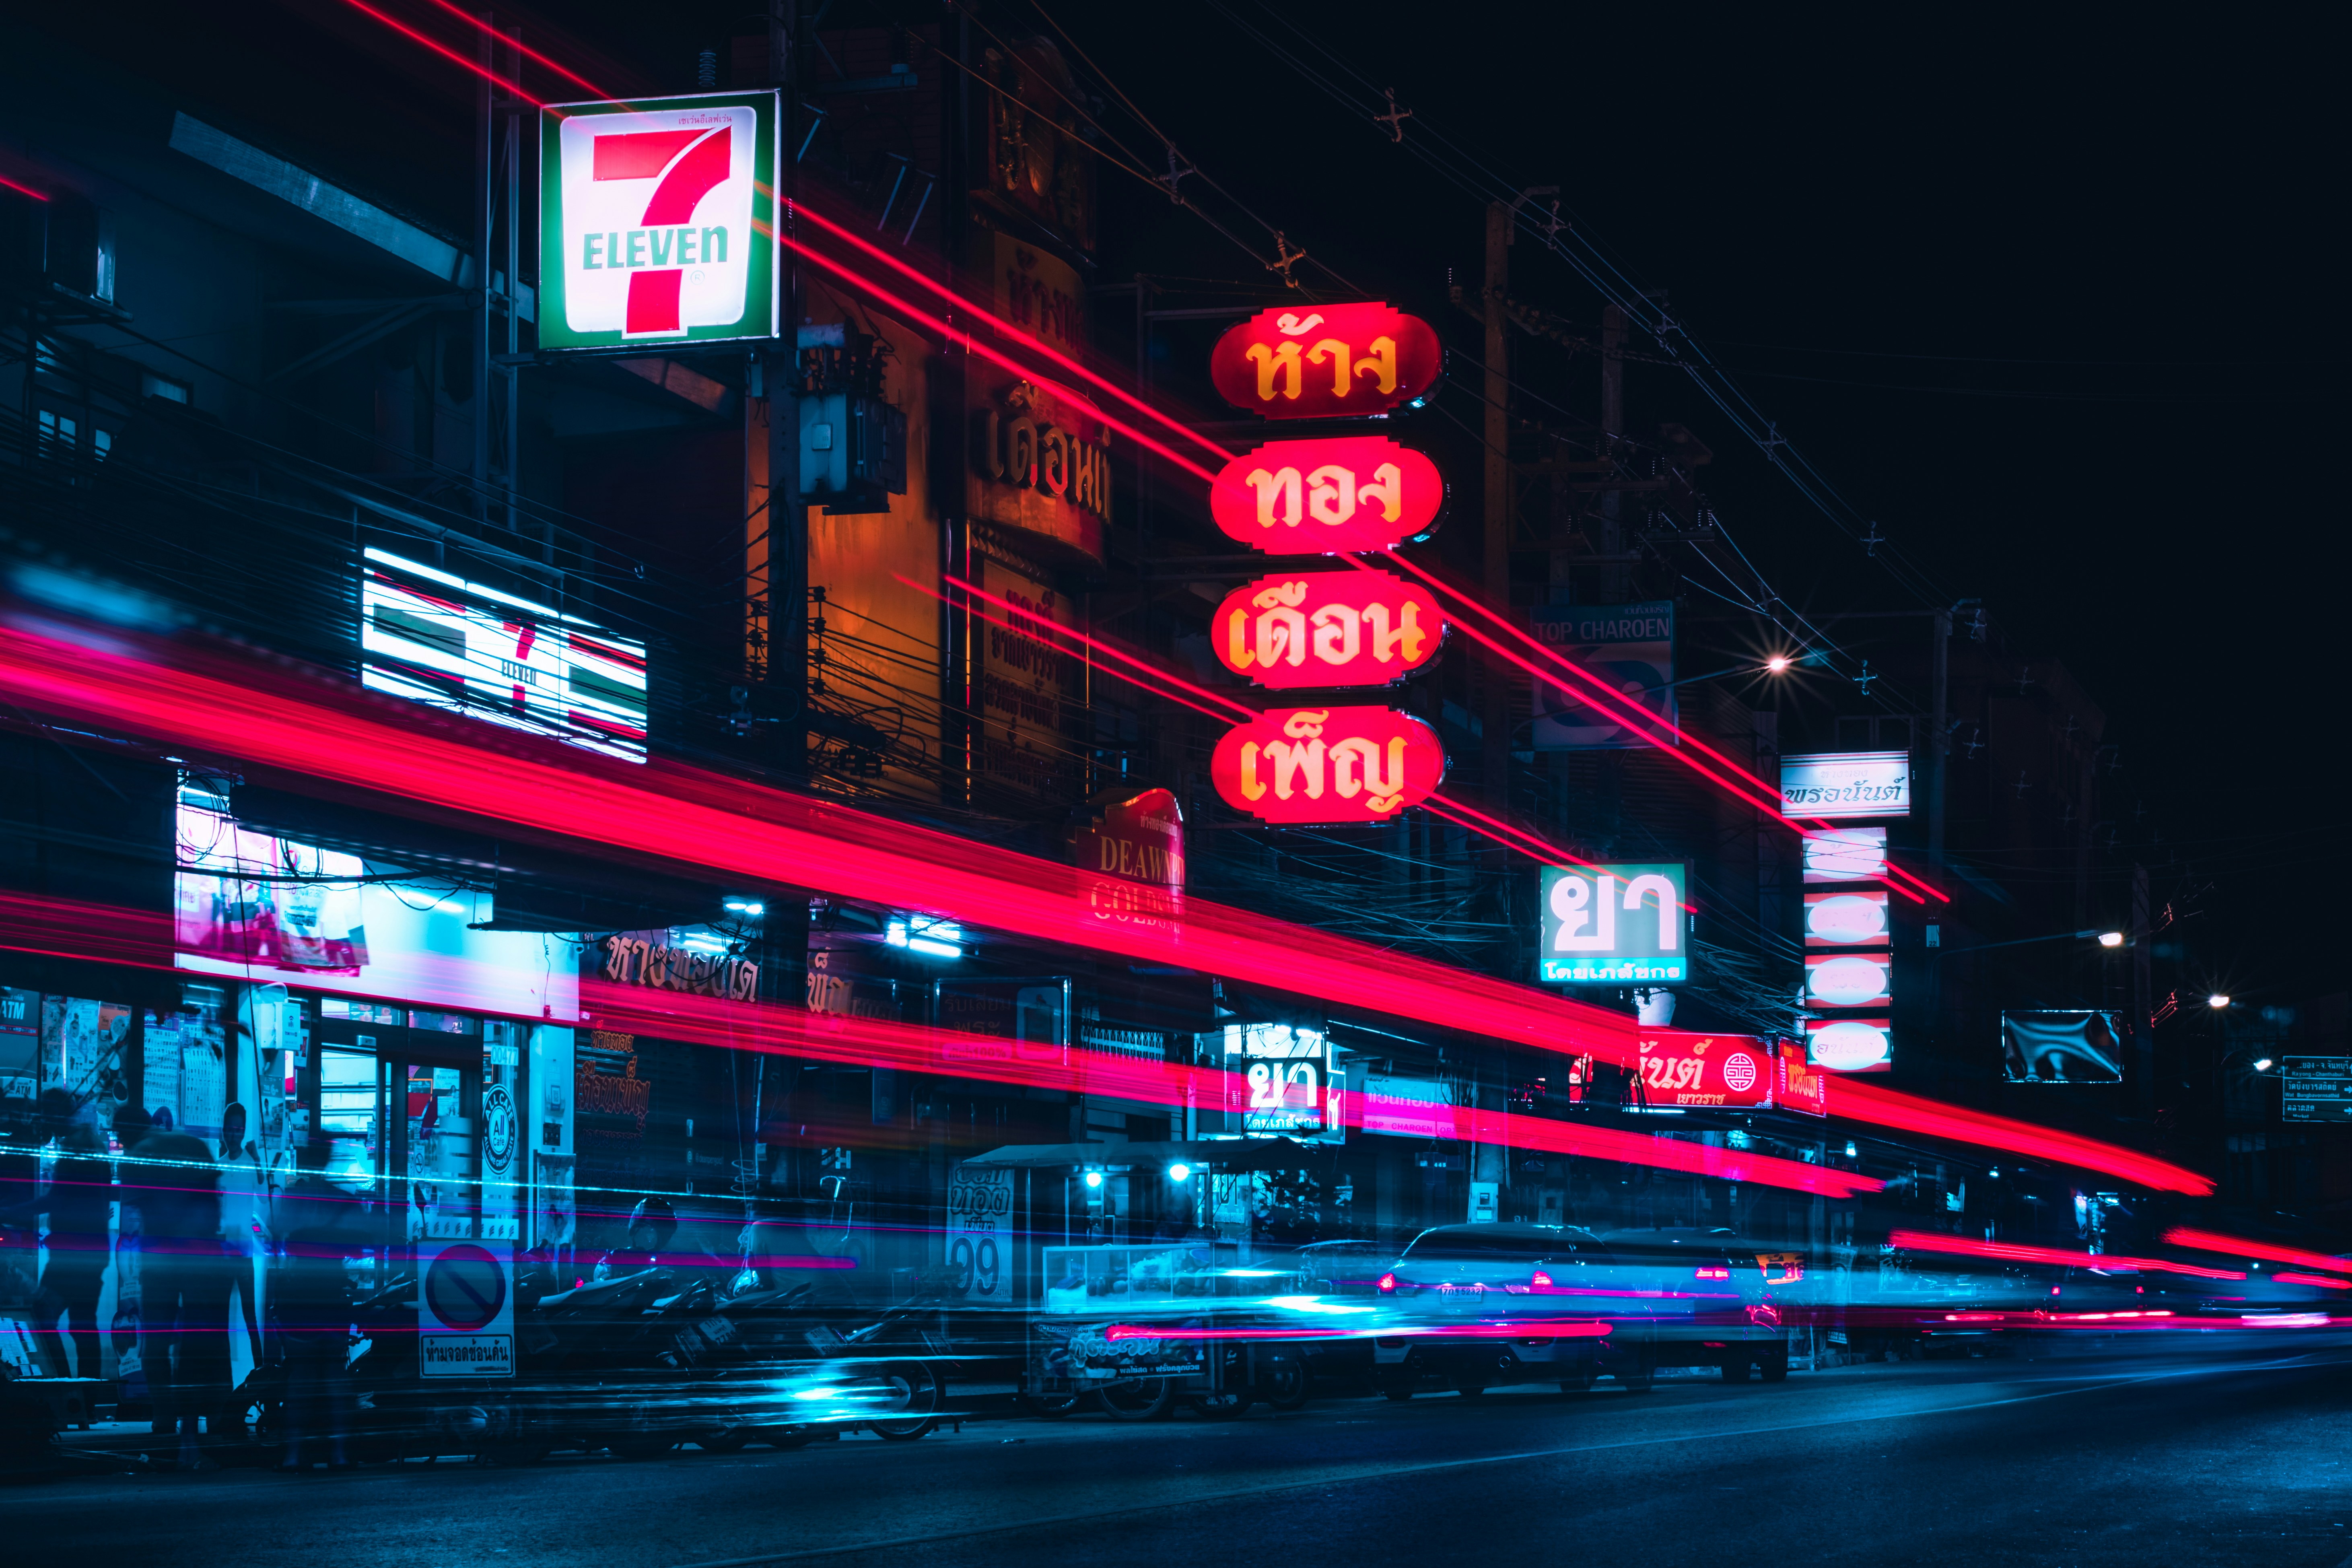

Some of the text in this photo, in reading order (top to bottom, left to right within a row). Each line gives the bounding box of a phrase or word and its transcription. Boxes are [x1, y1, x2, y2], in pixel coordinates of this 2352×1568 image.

[678, 114, 732, 125] เซเว่นอีเลฟเว่น
[583, 125, 731, 333] 7 ELEVEn
[1246, 313, 1396, 401] ห้าง
[1246, 462, 1402, 528] ทอง
[1229, 581, 1426, 670] เดือน
[1534, 618, 1670, 641] TOP CHAROEN
[1241, 709, 1408, 813] เพ็ญ
[1784, 777, 1906, 804] พรอนันต์
[1551, 874, 1676, 951] ยา
[1544, 962, 1680, 979] โดยเภสัชกร
[0, 1000, 25, 1020] ATM
[491, 1046, 518, 1064] 00477
[1248, 1063, 1317, 1107] ยา
[485, 1093, 514, 1121] ALL CAFE
[1676, 1094, 1726, 1105] เยาวราช
[493, 1115, 505, 1136] All
[1368, 1121, 1384, 1129] TOP
[1391, 1122, 1432, 1133] CHAROEN
[493, 1137, 505, 1146] Cafe
[950, 1236, 1001, 1297] 99
[426, 1338, 509, 1362] ห้ามจอดซ้อนคัน
[1119, 1364, 1147, 1375] ผลไม้สด
